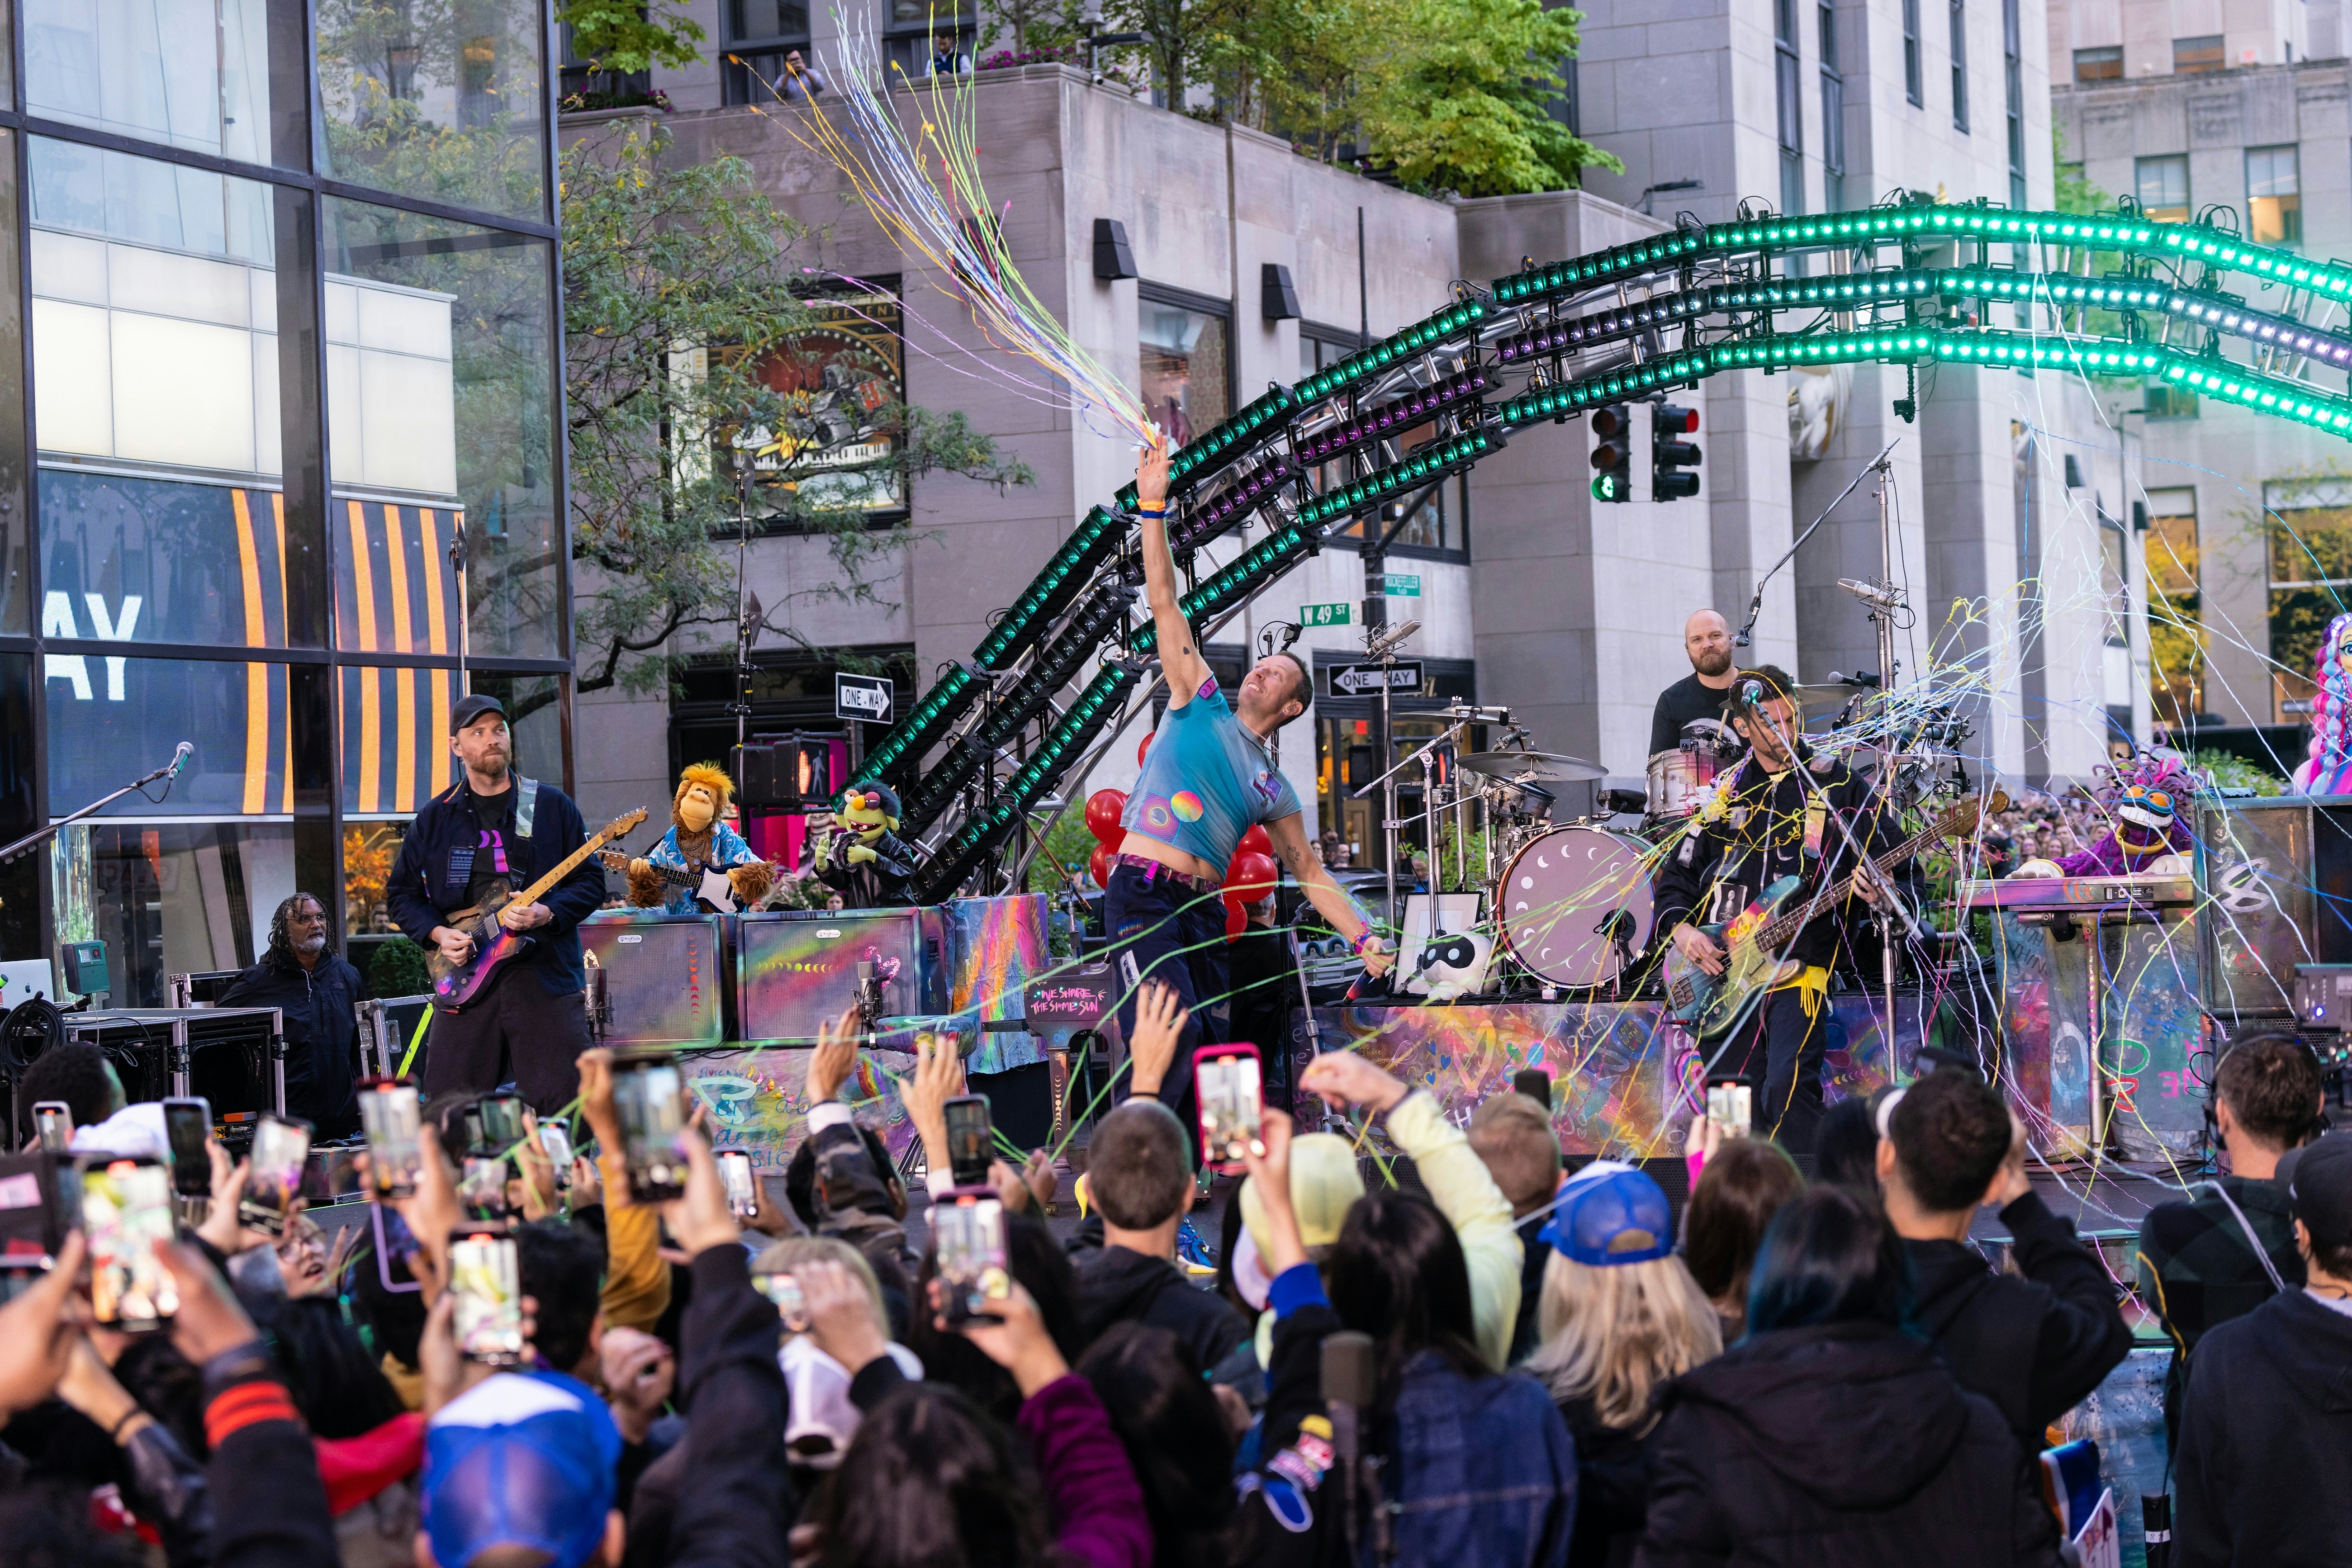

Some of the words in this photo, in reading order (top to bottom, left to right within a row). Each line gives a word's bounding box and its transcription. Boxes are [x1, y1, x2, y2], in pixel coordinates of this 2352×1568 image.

[1303, 606, 1313, 625] W
[1317, 605, 1332, 625] 49
[1335, 604, 1347, 615] ST
[1343, 673, 1370, 686] ONE
[845, 688, 861, 706] ONE
[868, 692, 884, 709] WAY
[1041, 988, 1059, 1001] WE
[1059, 987, 1096, 1000] SHARE
[1030, 1000, 1048, 1015] THE
[1049, 1000, 1077, 1012] SAME
[1078, 996, 1098, 1016] SUN
[1549, 1014, 1610, 1059] WORLD
[1617, 1019, 1634, 1039] LOOK
[1622, 1028, 1639, 1046] WITH
